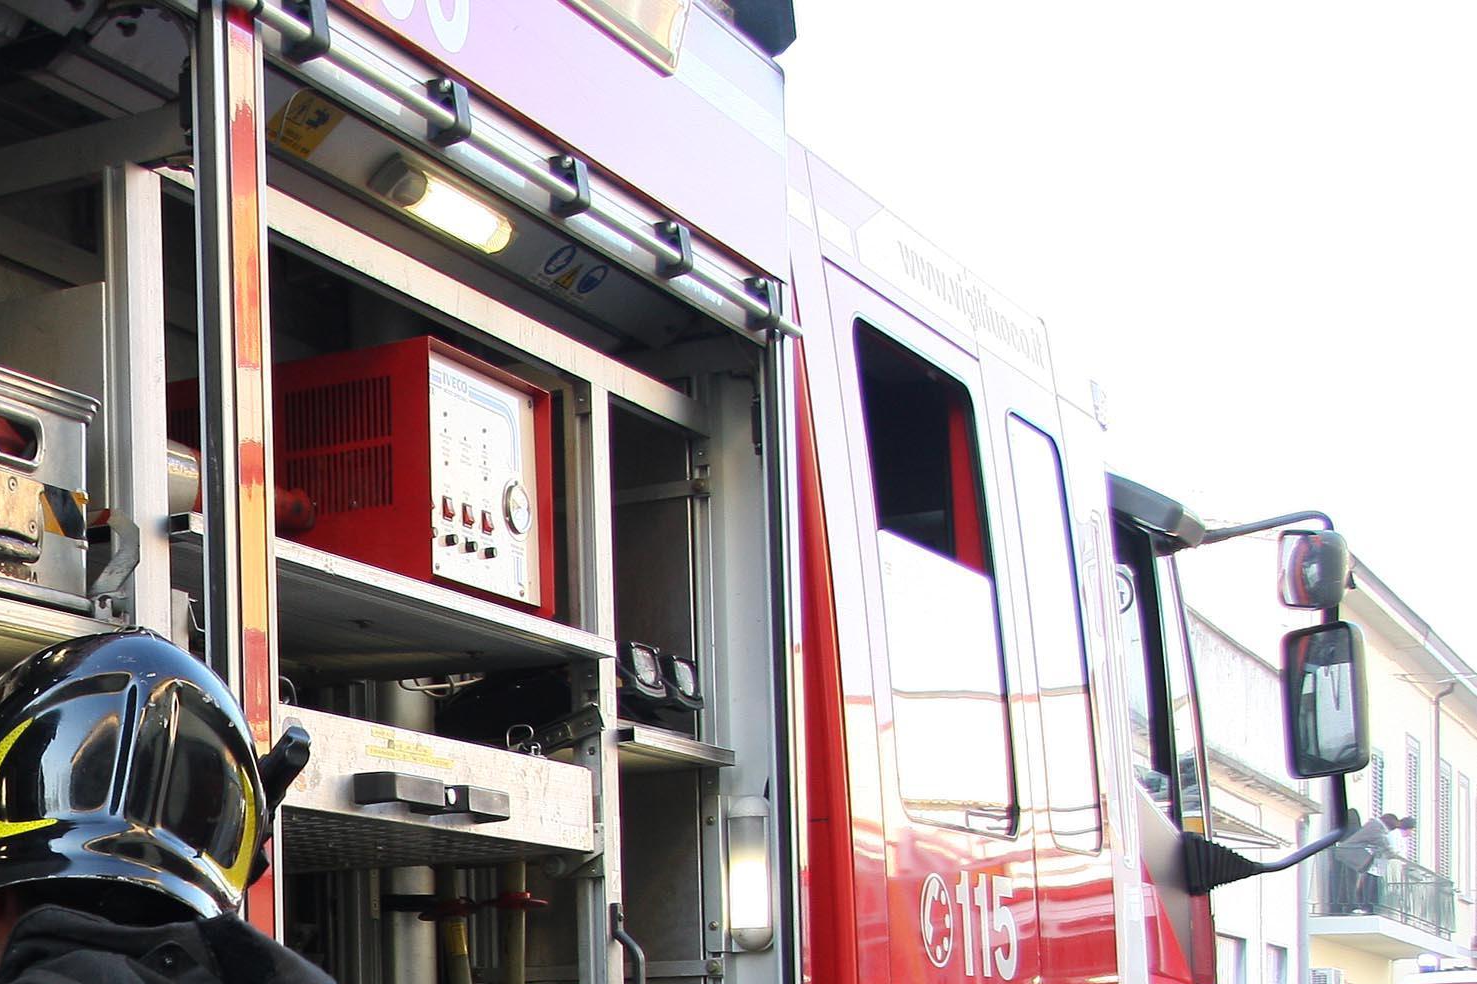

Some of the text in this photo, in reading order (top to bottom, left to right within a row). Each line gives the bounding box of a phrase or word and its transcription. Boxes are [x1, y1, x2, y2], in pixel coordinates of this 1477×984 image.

[896, 240, 1045, 370] www.vigilfuoco.it
[442, 371, 469, 395] IVECO
[955, 870, 1018, 981] 115
